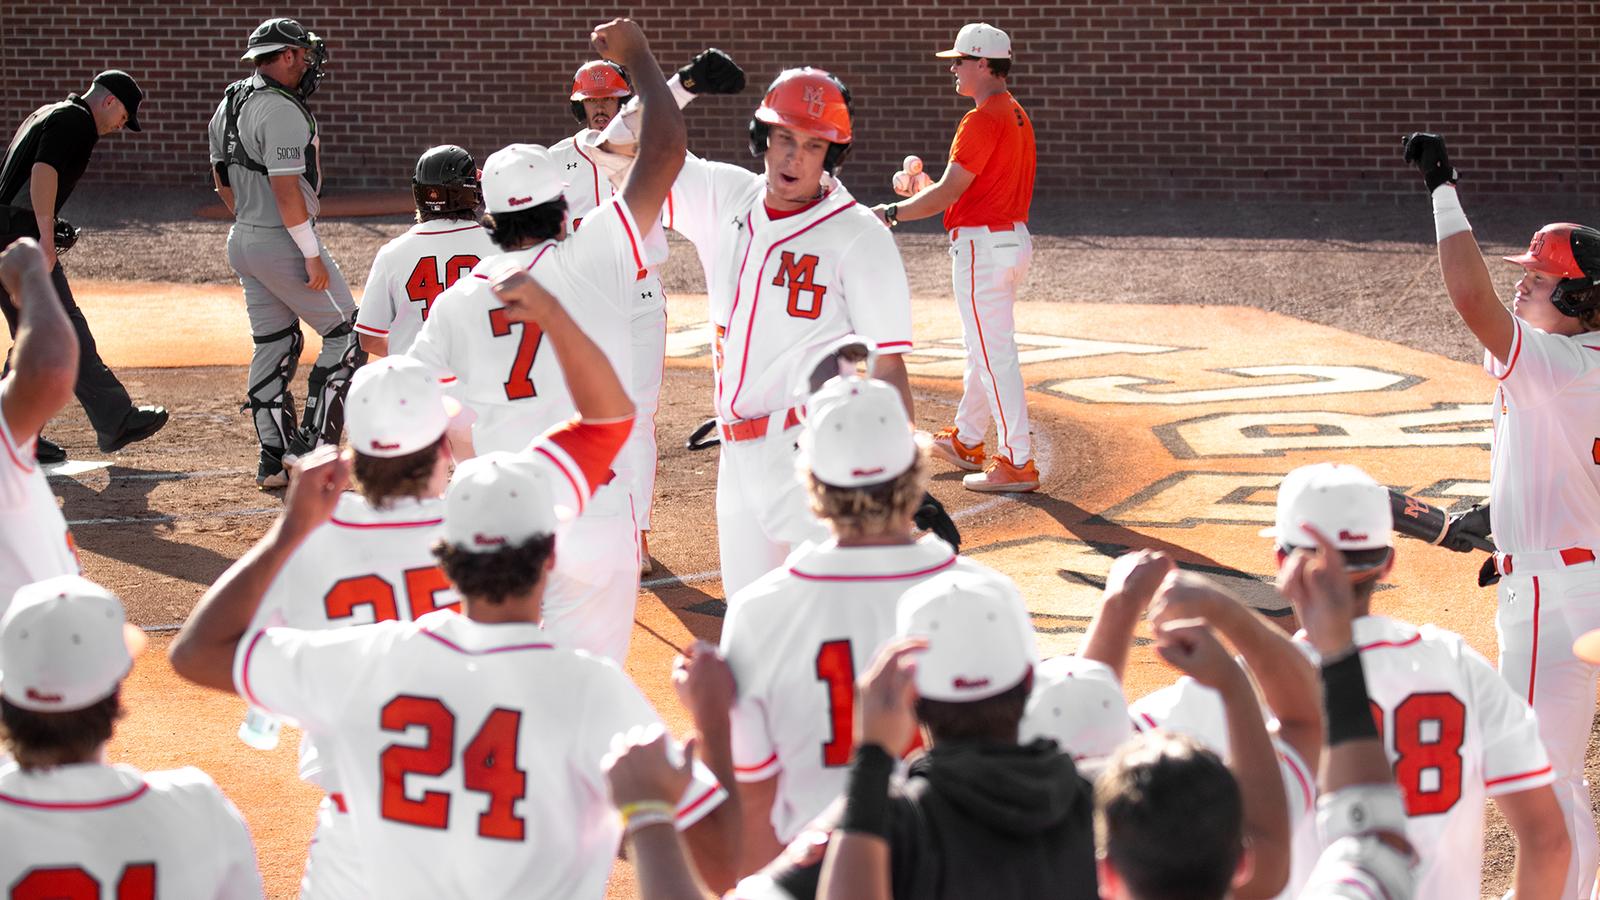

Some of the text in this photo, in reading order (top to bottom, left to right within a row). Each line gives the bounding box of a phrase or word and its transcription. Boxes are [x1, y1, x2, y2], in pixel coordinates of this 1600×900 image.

[772, 251, 827, 320] MU
[488, 306, 543, 400] 7
[379, 694, 525, 842] 24
[1369, 692, 1466, 816] 8
